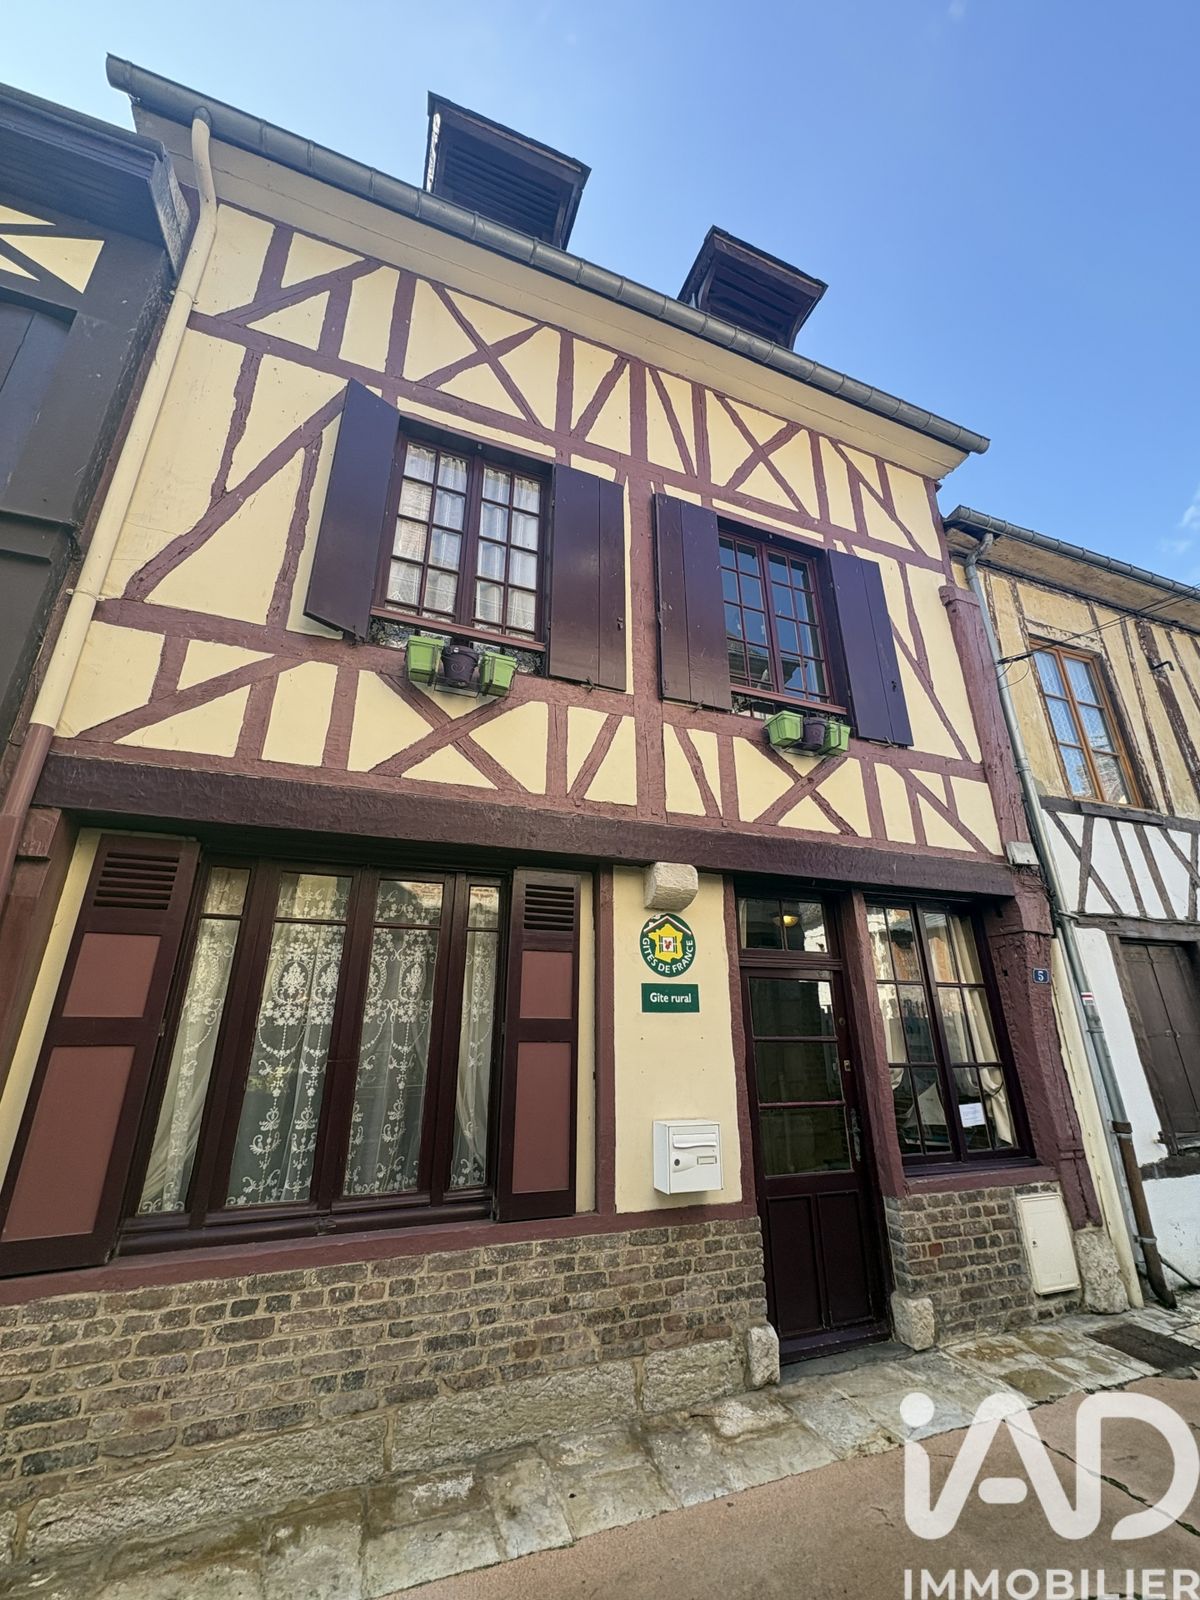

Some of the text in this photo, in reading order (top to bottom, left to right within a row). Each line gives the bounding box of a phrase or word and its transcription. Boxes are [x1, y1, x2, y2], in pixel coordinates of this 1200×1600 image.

[657, 963, 671, 974] DE
[672, 940, 694, 973] FRANCE
[1037, 970, 1044, 981] 5
[671, 992, 692, 1003] rural
